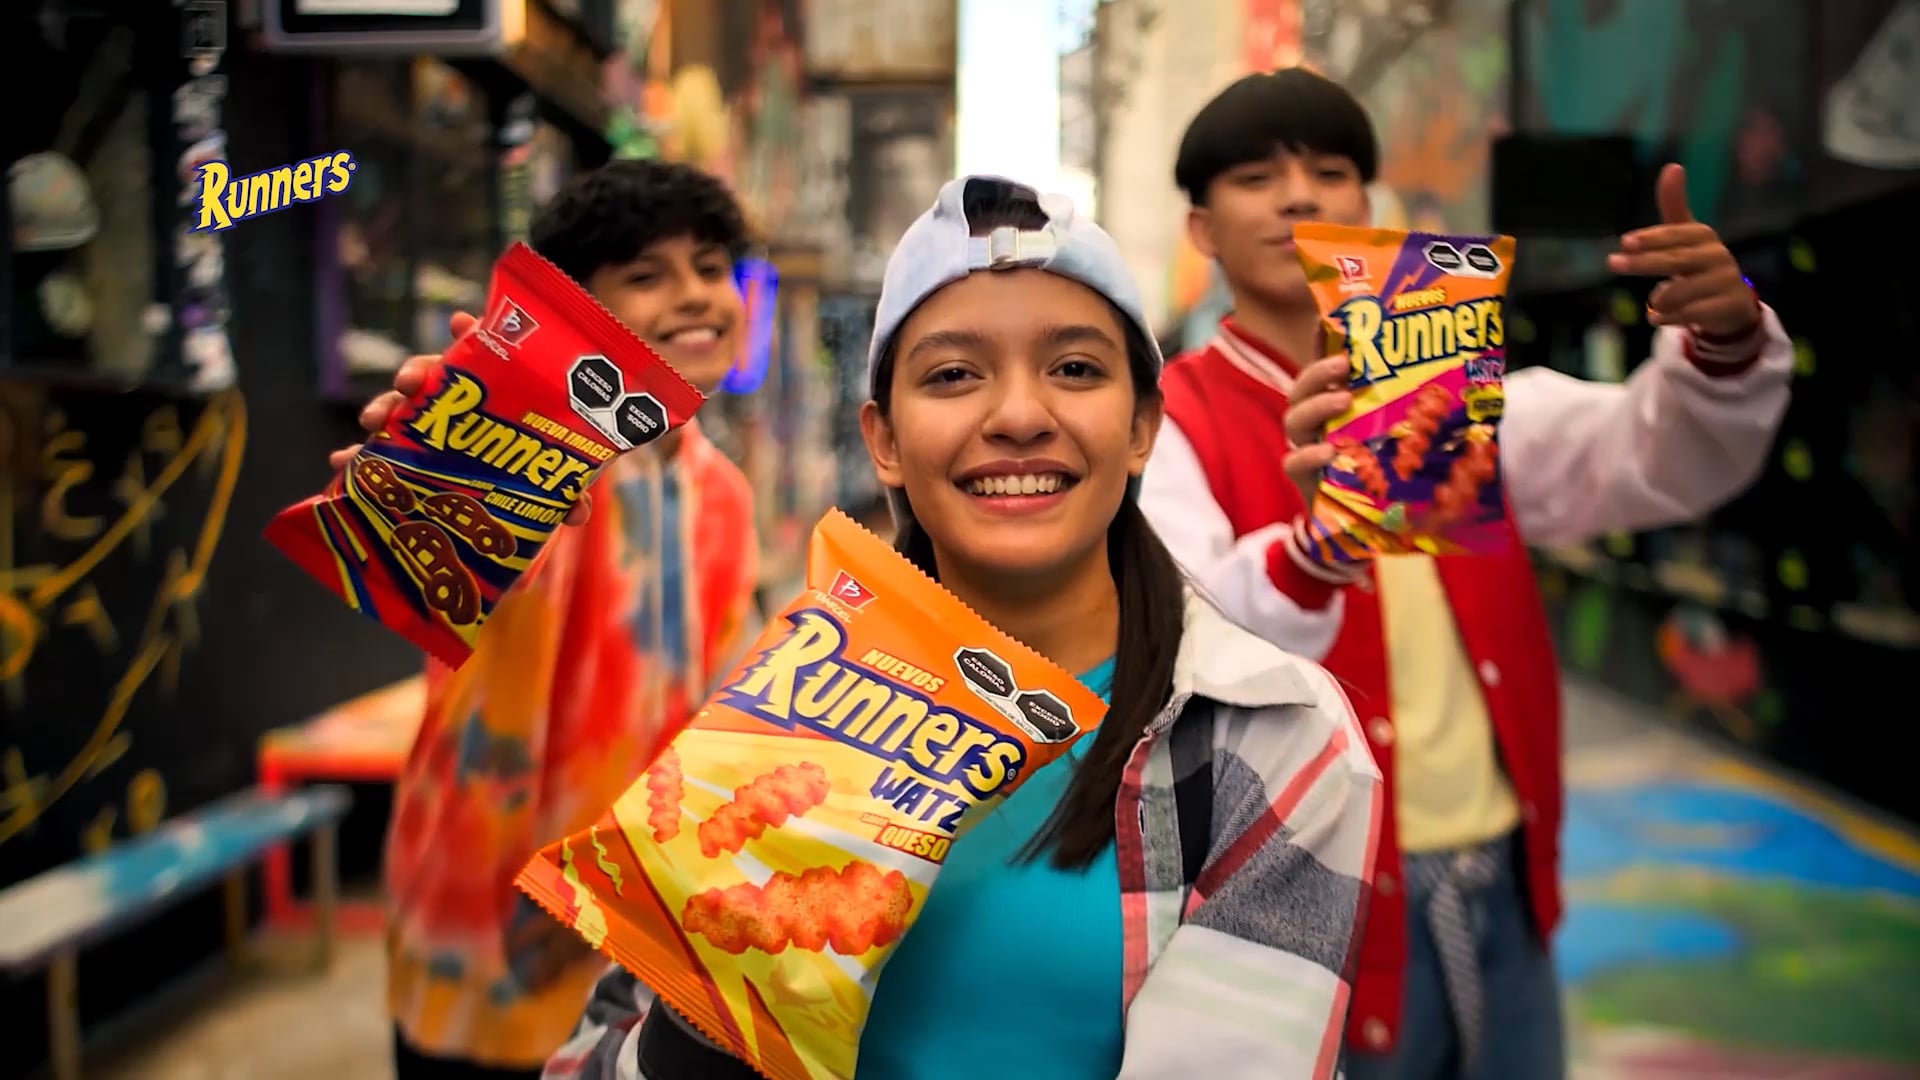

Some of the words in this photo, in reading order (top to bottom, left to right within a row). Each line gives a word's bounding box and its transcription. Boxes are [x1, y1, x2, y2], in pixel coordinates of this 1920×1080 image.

[577, 371, 611, 402] CALORIAS
[585, 366, 613, 393] EXCESO
[522, 411, 570, 441] NUEVA
[626, 413, 650, 434] SODIO
[629, 404, 658, 429] EXCESO
[484, 491, 519, 511] CHILE
[860, 648, 945, 693] NUEVOS
[963, 657, 1006, 693] CALORIAS
[970, 656, 1005, 685] EXCESO
[732, 612, 1021, 793] Runners
[1028, 701, 1066, 725] EXCESO
[869, 766, 971, 834] WATZ
[880, 825, 952, 861] QUESO
